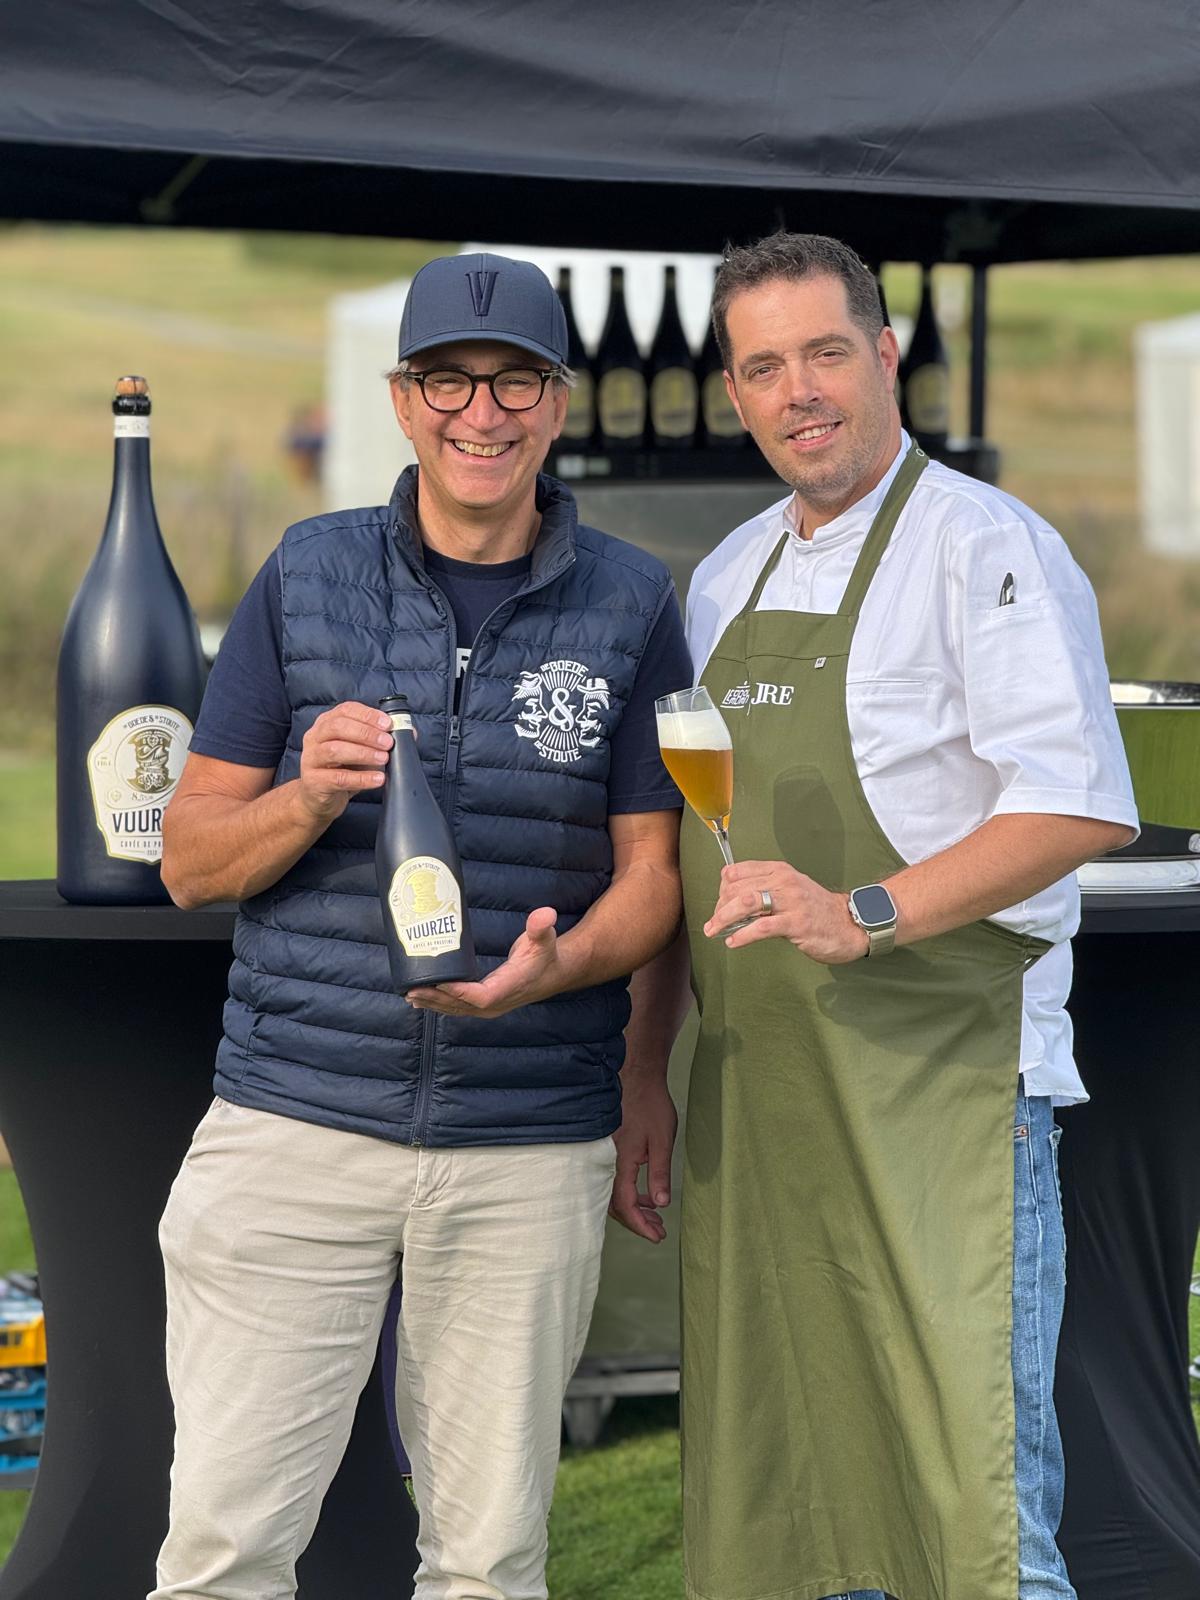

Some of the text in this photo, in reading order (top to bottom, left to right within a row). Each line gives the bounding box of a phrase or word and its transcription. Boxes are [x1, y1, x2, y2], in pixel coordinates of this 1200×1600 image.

[465, 271, 499, 316] V
[549, 687, 577, 732] &
[538, 745, 582, 763] STOUTE
[112, 806, 167, 833] VUUR
[406, 914, 457, 941] VUURZEE
